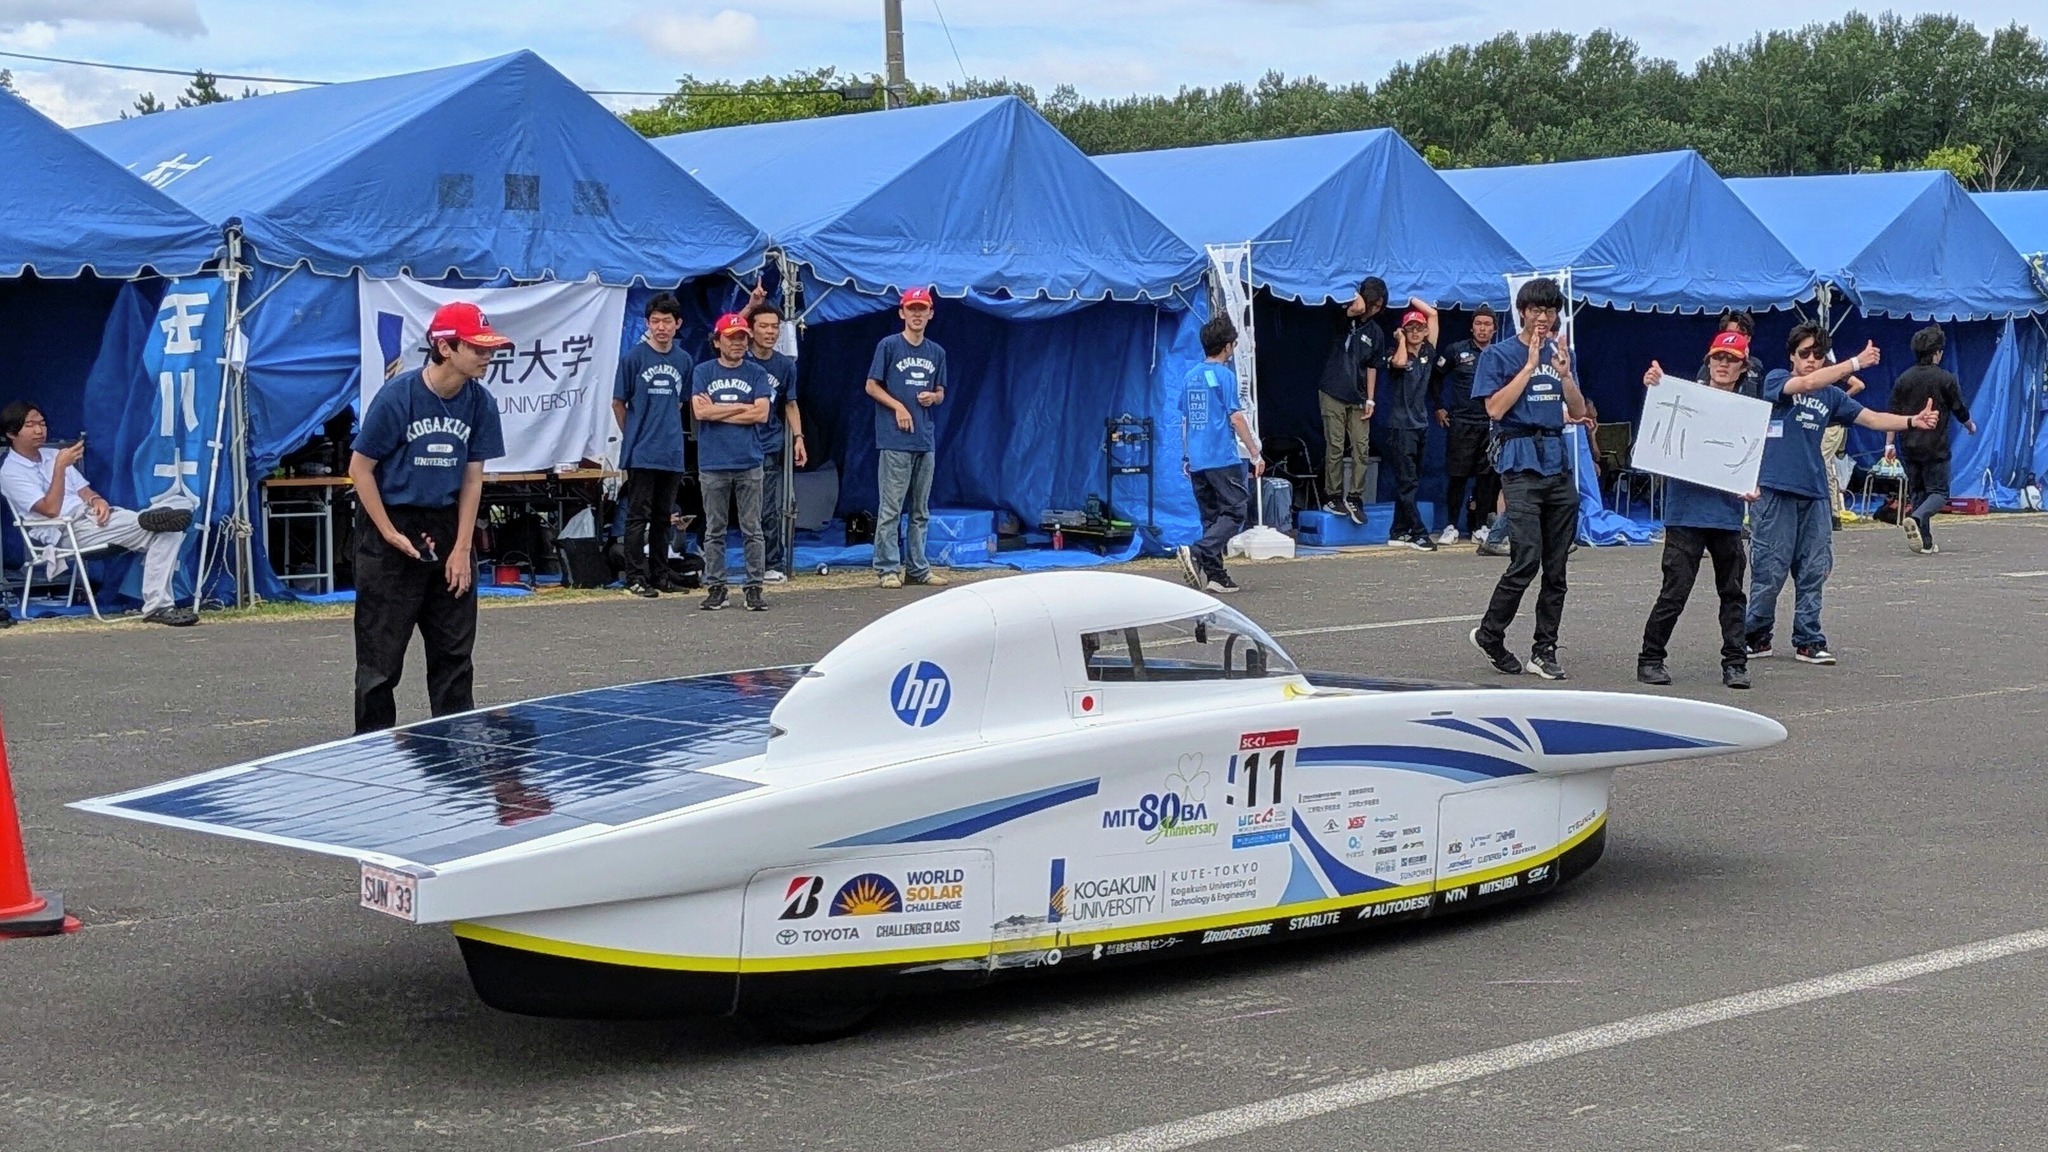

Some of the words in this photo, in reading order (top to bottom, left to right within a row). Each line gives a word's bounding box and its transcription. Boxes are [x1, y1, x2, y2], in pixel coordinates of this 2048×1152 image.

[499, 386, 588, 415] UNIVERSITY
[897, 662, 946, 728] hp
[1241, 737, 1266, 748] SC-C1
[1243, 750, 1286, 808] 11
[907, 869, 964, 886] WORLD
[1171, 861, 1259, 883] KUTE-TOKYO
[363, 876, 389, 908] SUN
[395, 884, 413, 914] 33
[906, 885, 962, 902] SOLAR
[1073, 874, 1157, 900] KOGAKUIN
[1170, 884, 1208, 897] Kogakuin
[1208, 878, 1247, 892] University
[1247, 876, 1257, 886] of
[1445, 886, 1468, 904] NTN
[1478, 875, 1519, 896] MITSUBA
[905, 900, 962, 914] CHALLENGE
[1072, 895, 1155, 921] UNIVERSITY
[1170, 896, 1210, 908] Technology
[1210, 893, 1216, 902] &
[1216, 889, 1257, 902] Engineering
[1372, 895, 1432, 918] AUTODESK
[876, 923, 932, 938] CHALLENGER
[933, 920, 961, 934] CLASS
[1289, 911, 1341, 931] STARLITE
[803, 927, 860, 943] TOYOTA
[1201, 923, 1274, 944] BRIDGESTONE
